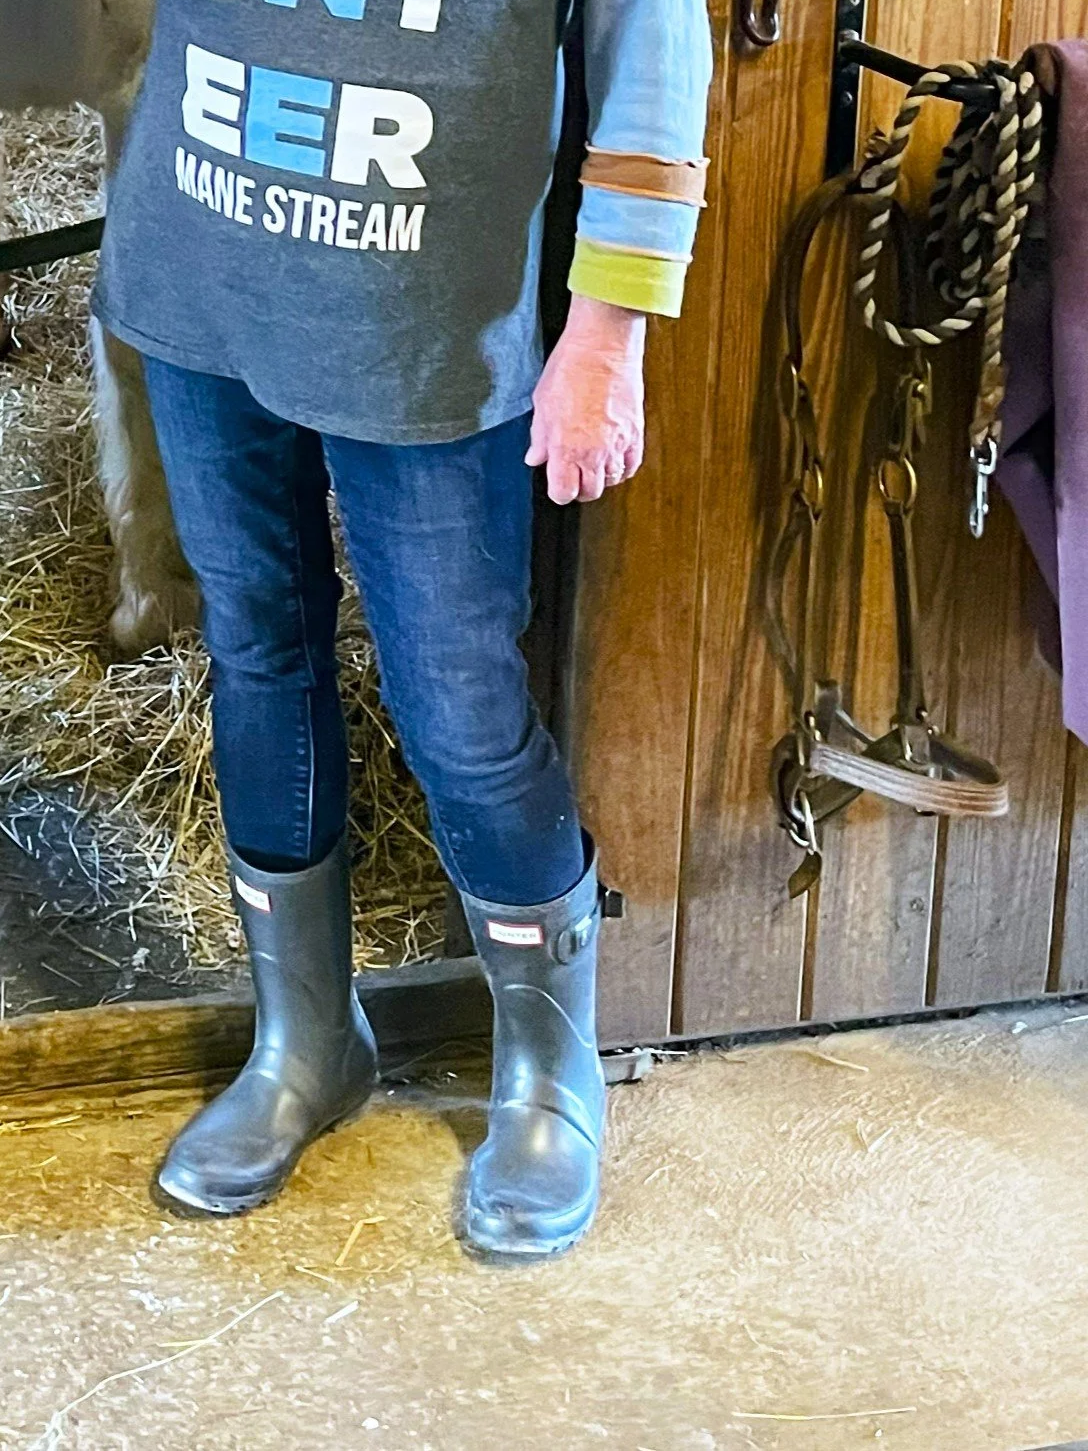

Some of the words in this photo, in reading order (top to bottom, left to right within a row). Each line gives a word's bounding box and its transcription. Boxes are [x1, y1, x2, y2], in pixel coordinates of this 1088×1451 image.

[181, 43, 434, 189] EER
[175, 146, 256, 226] MANE
[262, 184, 426, 252] STREAM
